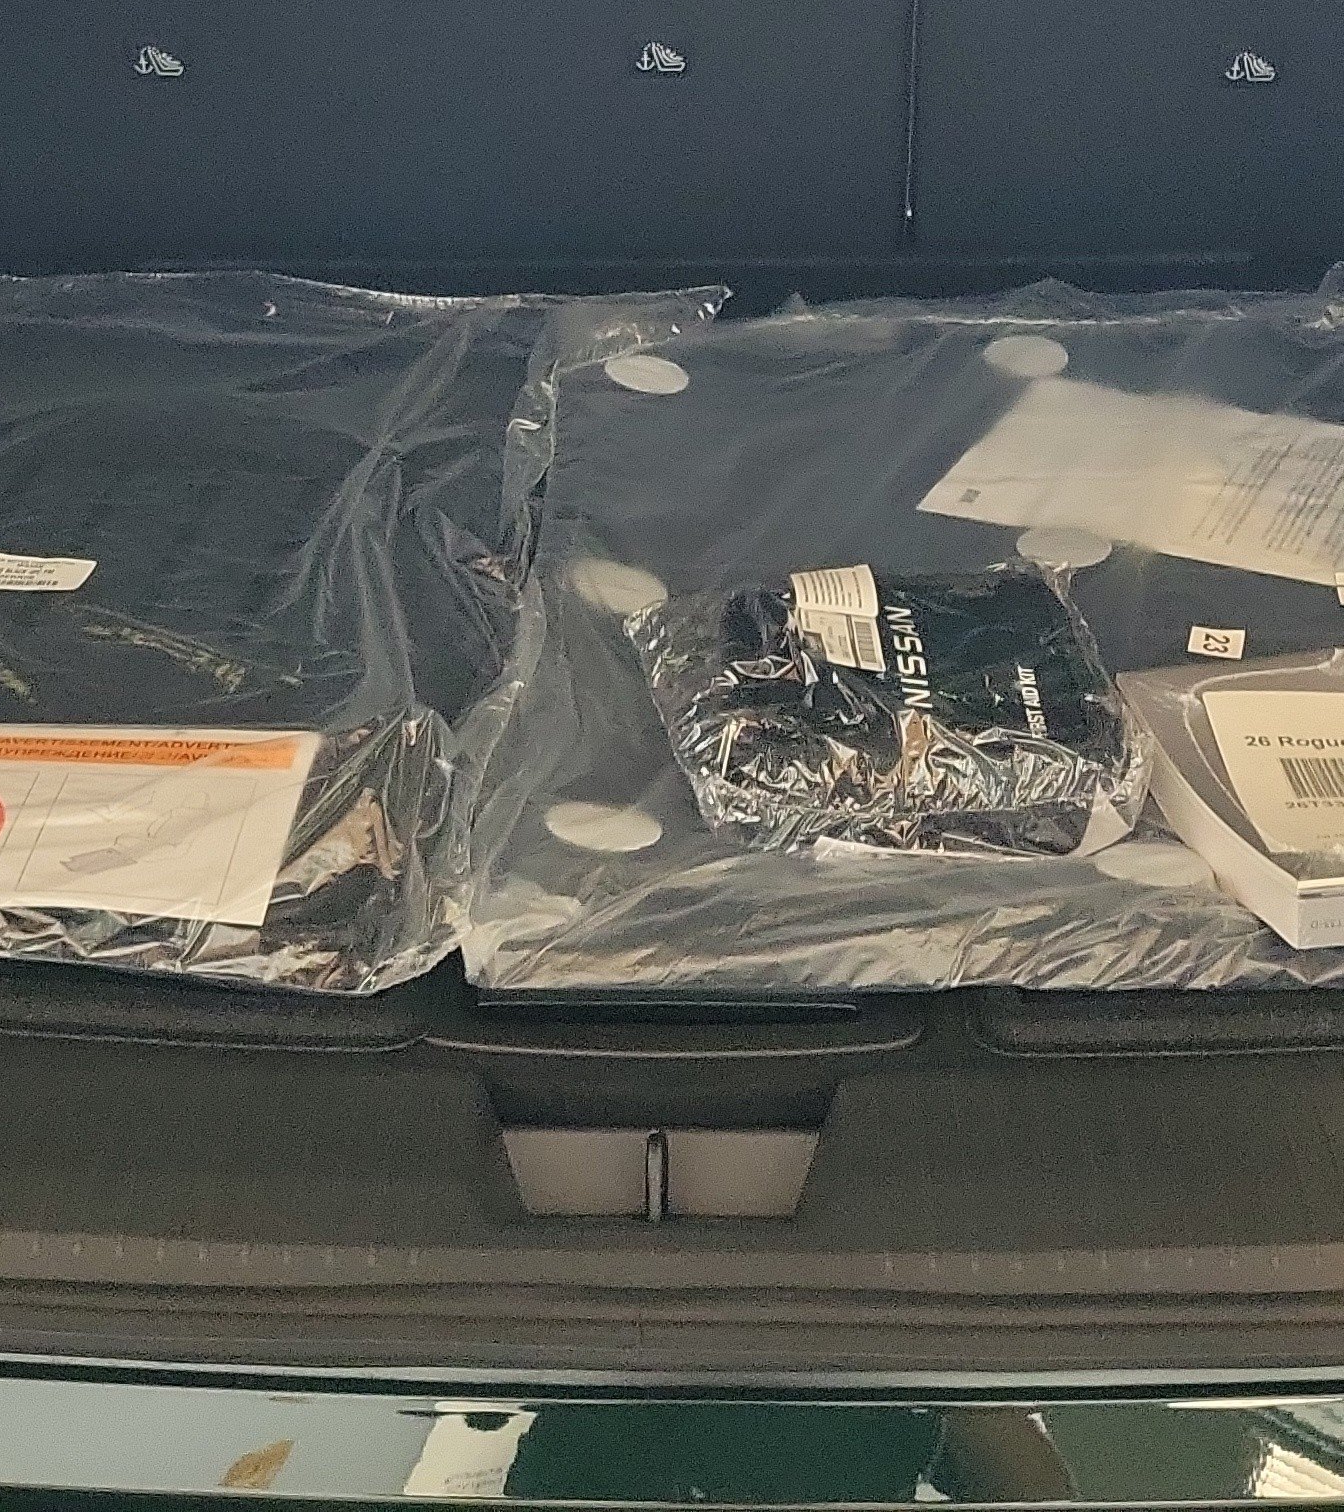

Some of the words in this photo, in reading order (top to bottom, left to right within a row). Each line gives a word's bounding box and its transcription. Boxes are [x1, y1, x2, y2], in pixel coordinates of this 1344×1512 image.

[1202, 633, 1231, 654] 23
[884, 605, 934, 709] NISSAN
[1017, 664, 1037, 686] KIT
[1021, 687, 1041, 708] AID
[1244, 735, 1272, 747] 26
